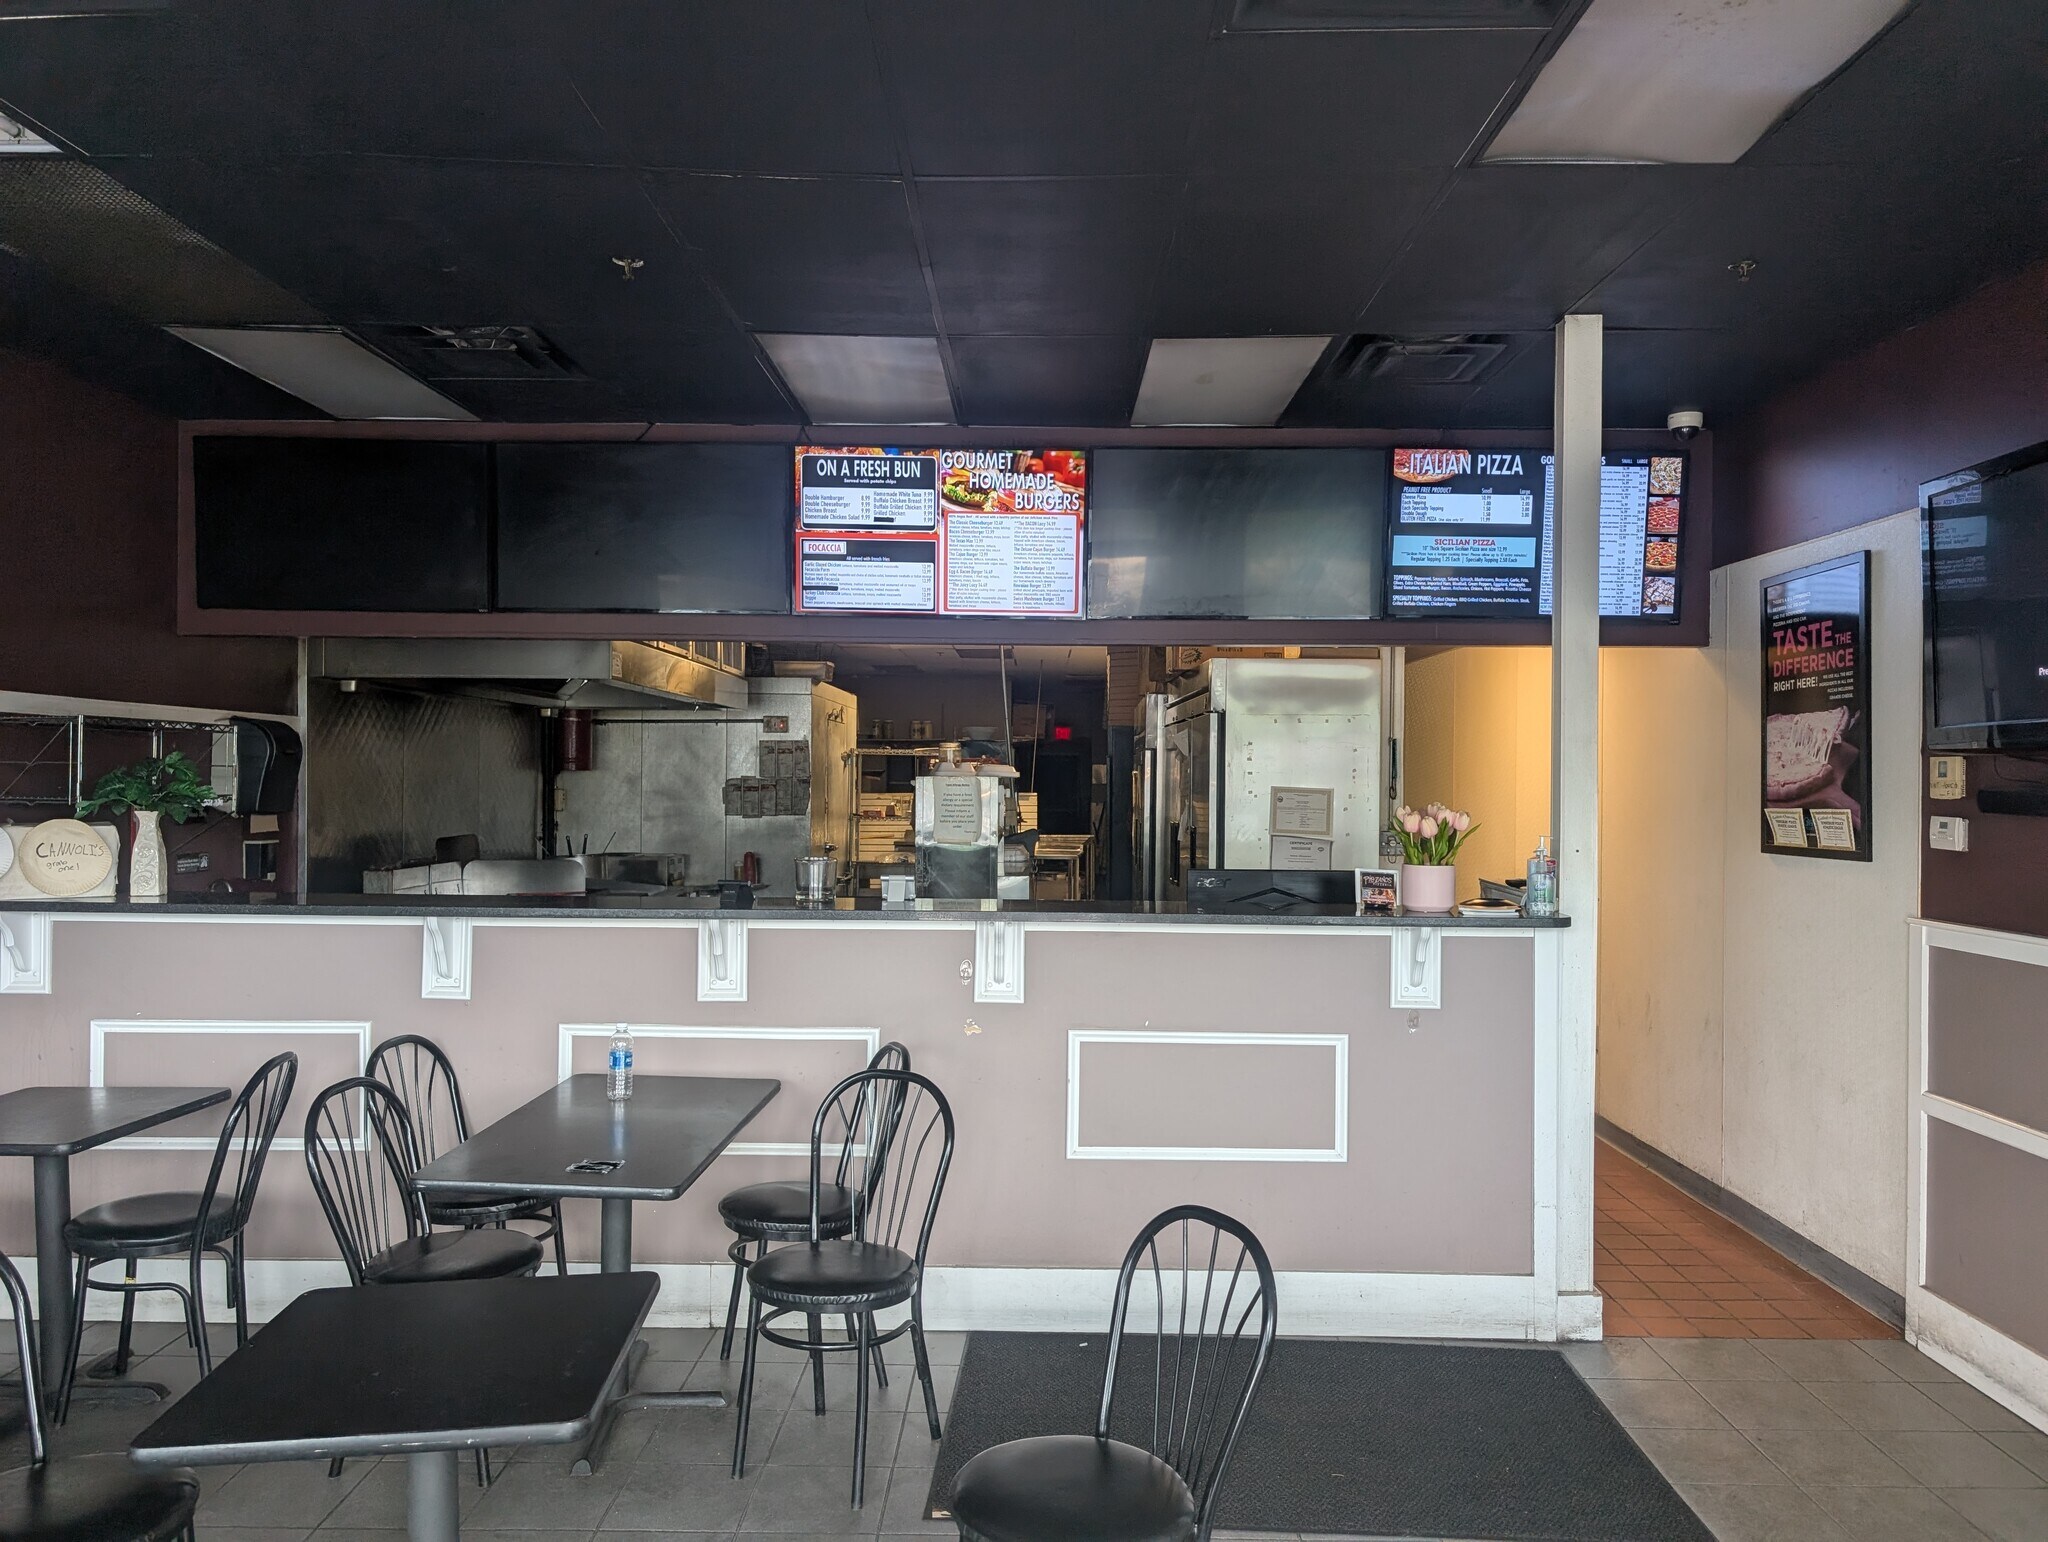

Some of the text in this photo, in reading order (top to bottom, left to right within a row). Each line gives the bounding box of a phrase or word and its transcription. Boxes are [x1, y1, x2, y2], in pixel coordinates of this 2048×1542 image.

[817, 459, 921, 478] ON A FRESH BUN
[942, 452, 1013, 469] GOURMET
[1410, 453, 1524, 475] ITALIAN PIZZA
[970, 472, 1054, 490] HOMEMADE
[1520, 488, 1531, 496] Large
[1015, 492, 1080, 510] BURGERS
[808, 543, 842, 552] FOCACCIA
[1434, 538, 1470, 546] SICILIAN
[1773, 620, 1852, 655] TASTE THE
[1773, 648, 1854, 678] DIFFERENCE
[1774, 676, 1818, 692] RIGHT HERE!
[36, 842, 105, 858] CANNOLI'S
[47, 860, 68, 870] grab
[58, 863, 79, 872] one!
